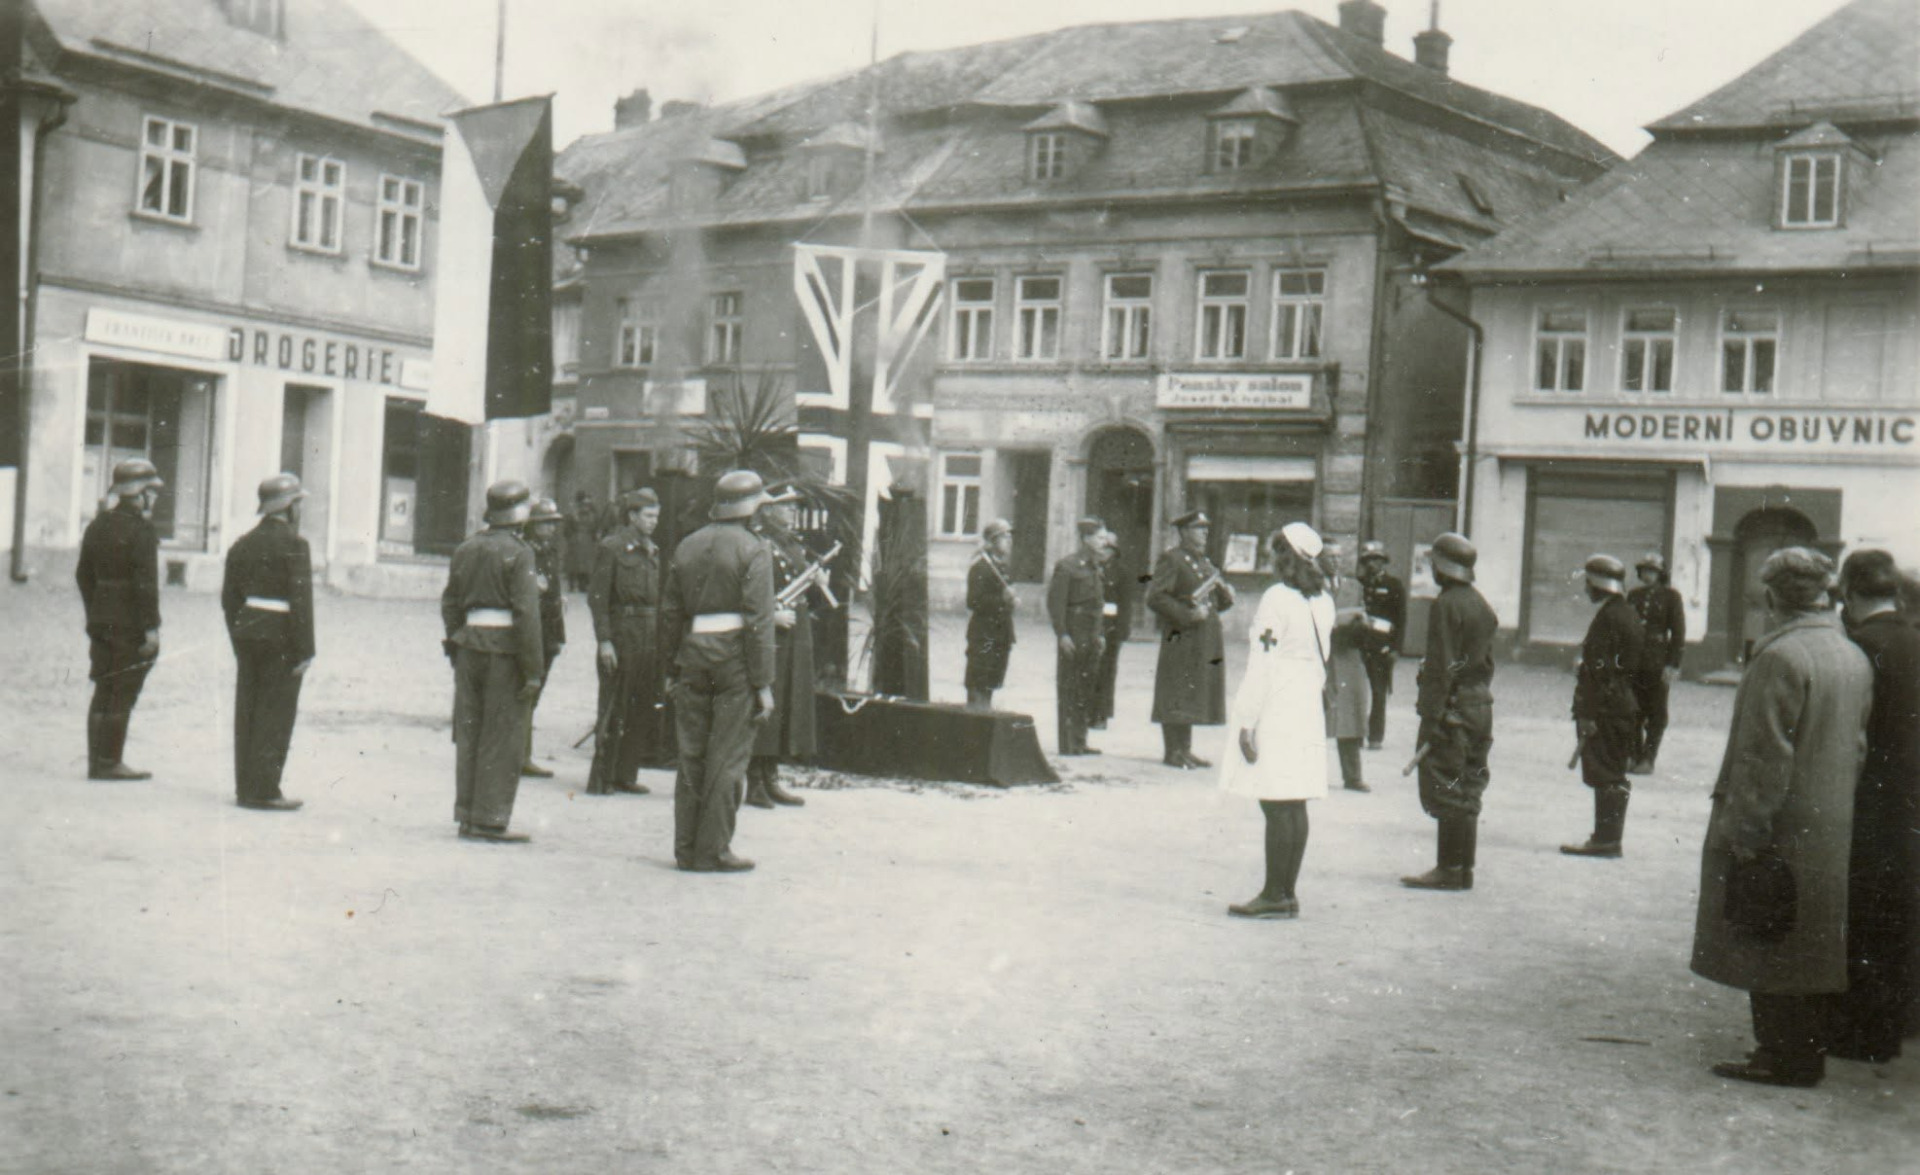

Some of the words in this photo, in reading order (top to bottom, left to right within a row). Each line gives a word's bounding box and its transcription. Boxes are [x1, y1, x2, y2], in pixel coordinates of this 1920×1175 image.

[229, 326, 393, 384] DROGERIE
[1248, 376, 1303, 391] salon
[1584, 408, 1734, 440] MODERNÍ
[1750, 415, 1915, 443] OBUVNIC
